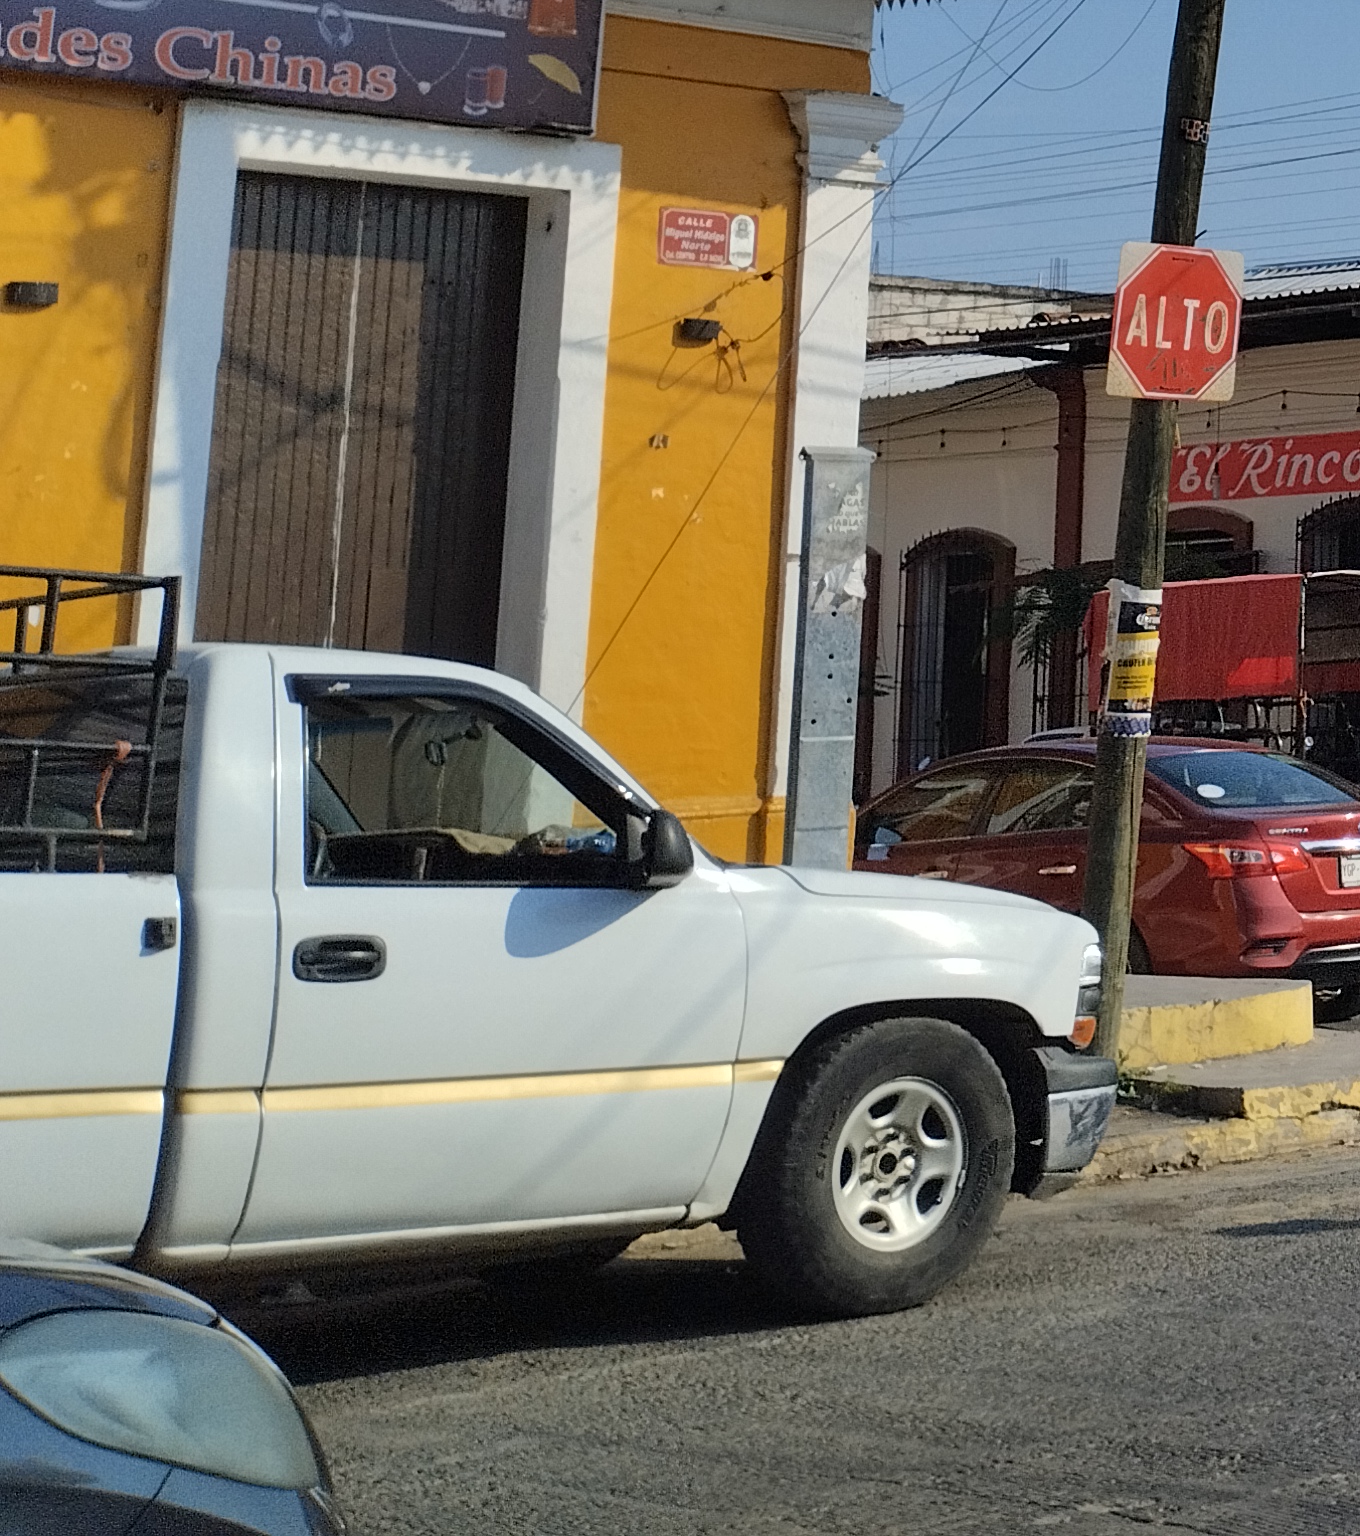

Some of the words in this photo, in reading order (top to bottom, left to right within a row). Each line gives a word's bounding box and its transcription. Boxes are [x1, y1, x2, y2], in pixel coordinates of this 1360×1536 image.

[0, 5, 133, 71] des
[154, 26, 397, 101] Chinas
[665, 227, 693, 240] Miguel
[694, 229, 725, 243] Hidalgo
[678, 216, 713, 227] CALLE
[681, 240, 711, 251] Norte
[1125, 293, 1229, 355] ALTO
[1176, 441, 1232, 493] El
